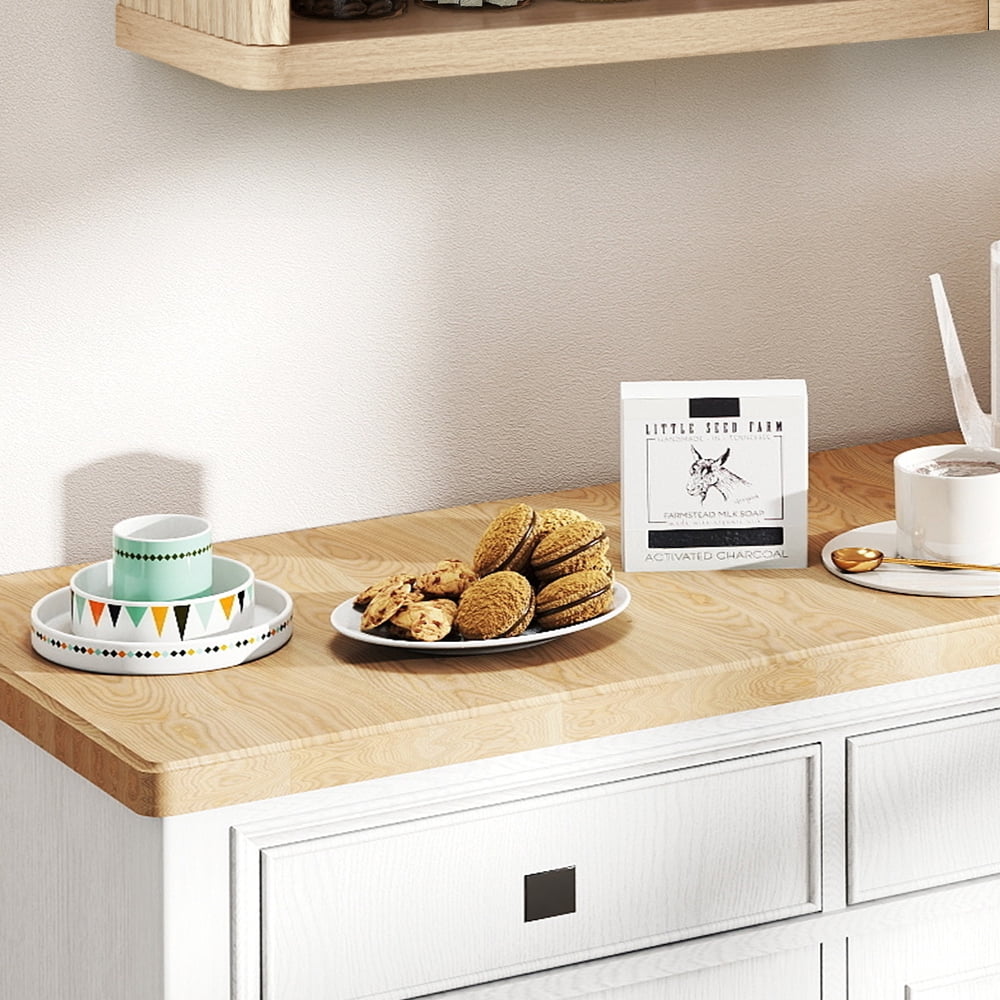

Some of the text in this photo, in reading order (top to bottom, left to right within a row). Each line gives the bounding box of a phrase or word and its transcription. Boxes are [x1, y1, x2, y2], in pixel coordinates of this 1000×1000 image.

[645, 421, 783, 435] LITTLE SEED FARM
[663, 509, 765, 519] FARMSTEAD MILK SOAP
[645, 549, 789, 562] ACTIVATED CHARCOAL
